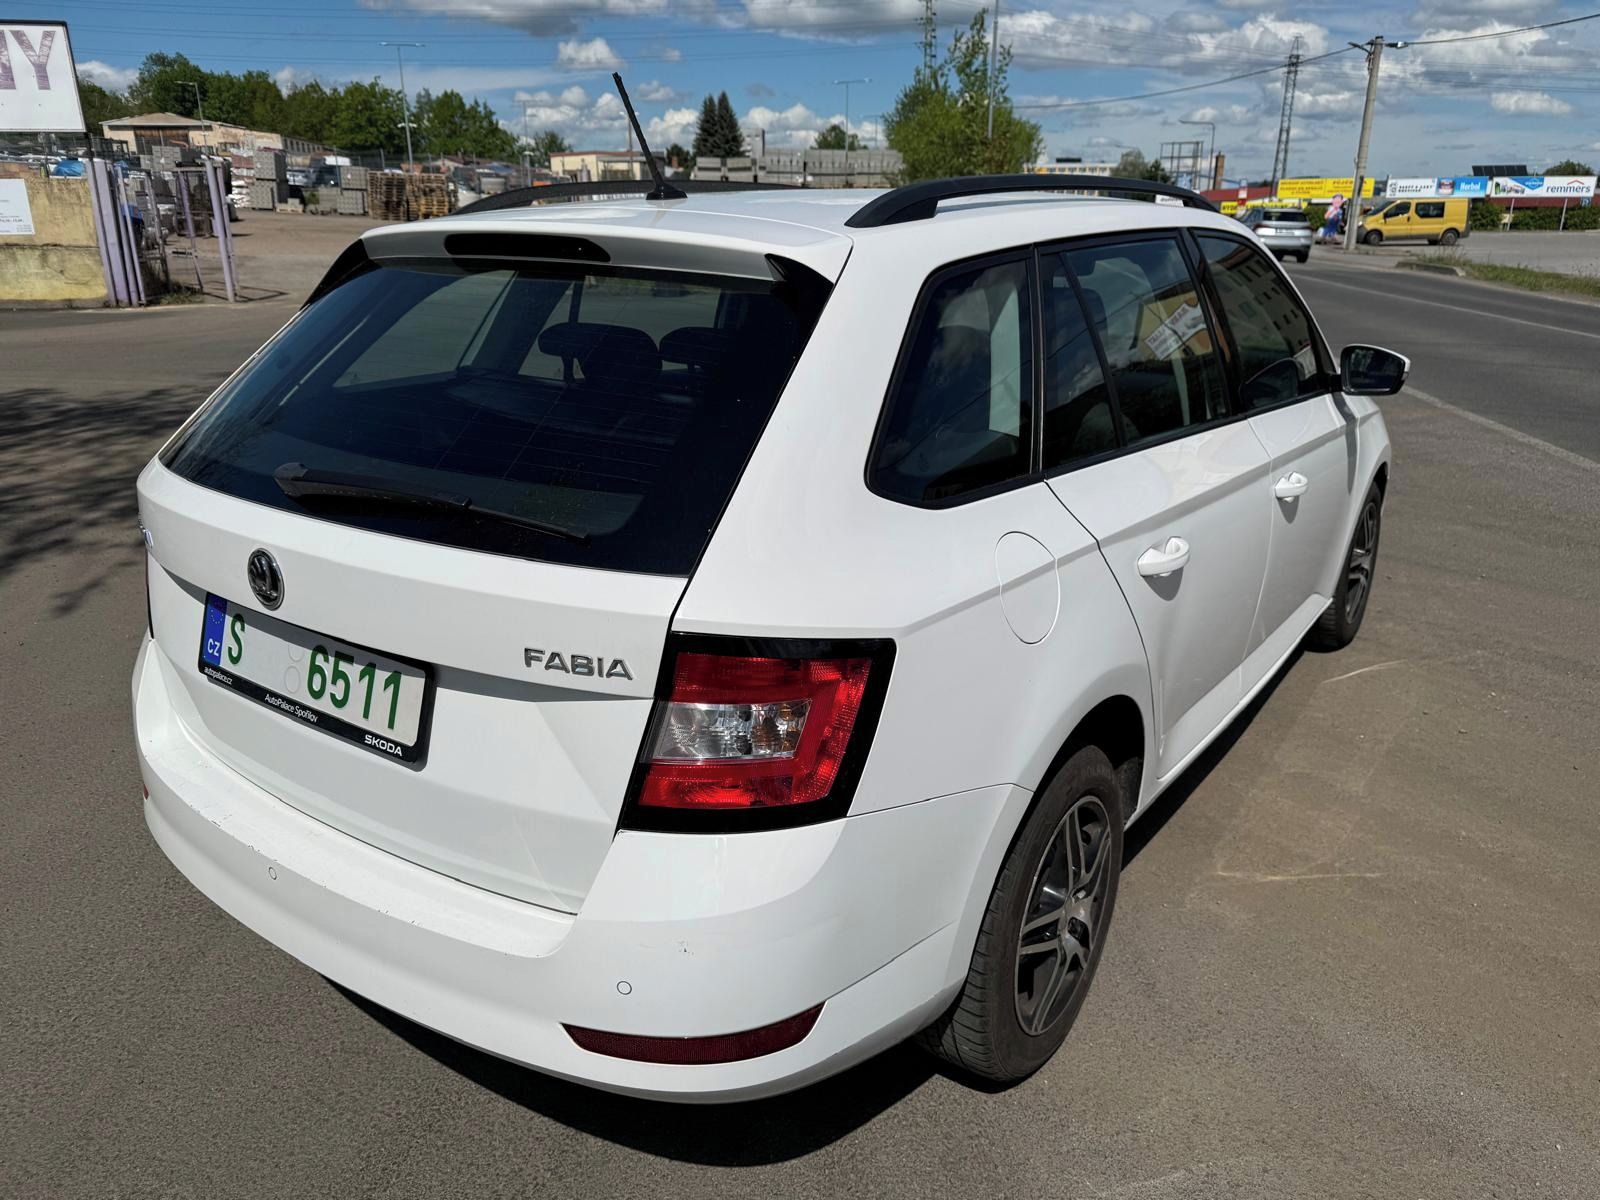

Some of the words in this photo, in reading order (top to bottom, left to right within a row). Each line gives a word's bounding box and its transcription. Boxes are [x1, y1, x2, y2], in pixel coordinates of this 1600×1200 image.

[1546, 185, 1591, 193] remmers
[207, 638, 220, 657] CZ
[227, 613, 246, 665] S
[307, 644, 403, 730] 6511
[524, 647, 634, 681] FABIA
[264, 693, 295, 713] AutoPalace
